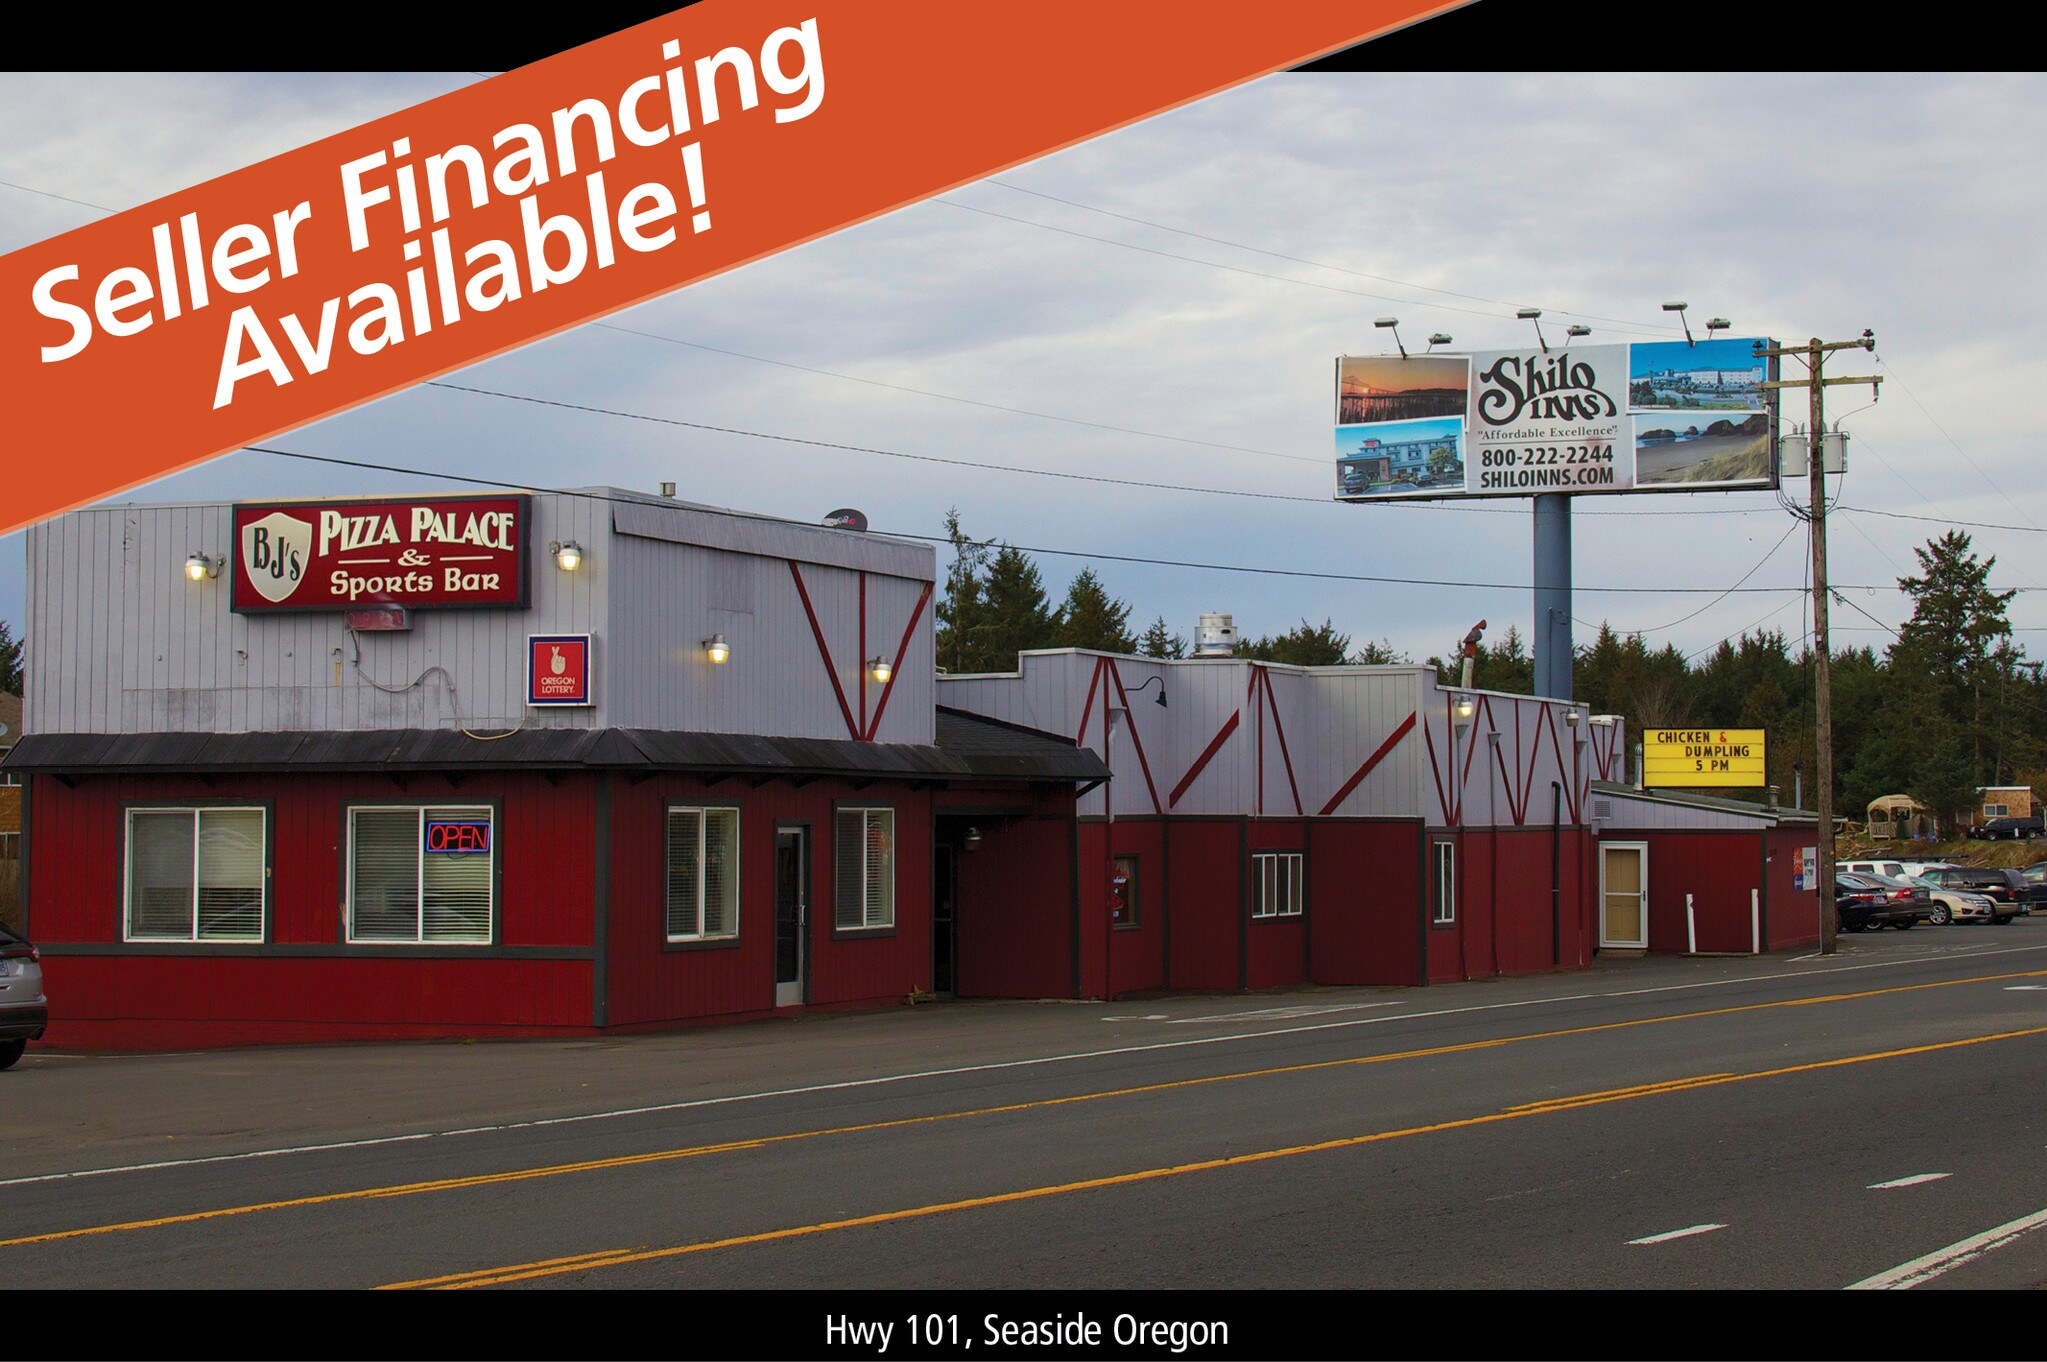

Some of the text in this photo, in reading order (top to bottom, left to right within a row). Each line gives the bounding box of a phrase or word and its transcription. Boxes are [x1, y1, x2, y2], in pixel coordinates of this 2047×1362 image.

[1478, 353, 1617, 426] Shilo
[1477, 425, 1618, 440] "Affordable Excellence"
[1481, 445, 1614, 467] 800-222-2244
[1480, 467, 1614, 488] SHILOINNS.COM
[318, 507, 514, 558] PIZZA PALACE
[397, 548, 431, 567] &
[330, 568, 501, 600] Sports Bar
[541, 677, 576, 685] OREGON
[1657, 731, 1727, 743] CHICKEN &
[1685, 745, 1750, 757] DUMPLING
[1696, 760, 1729, 771] 5 PM
[430, 825, 488, 850] OPEN
